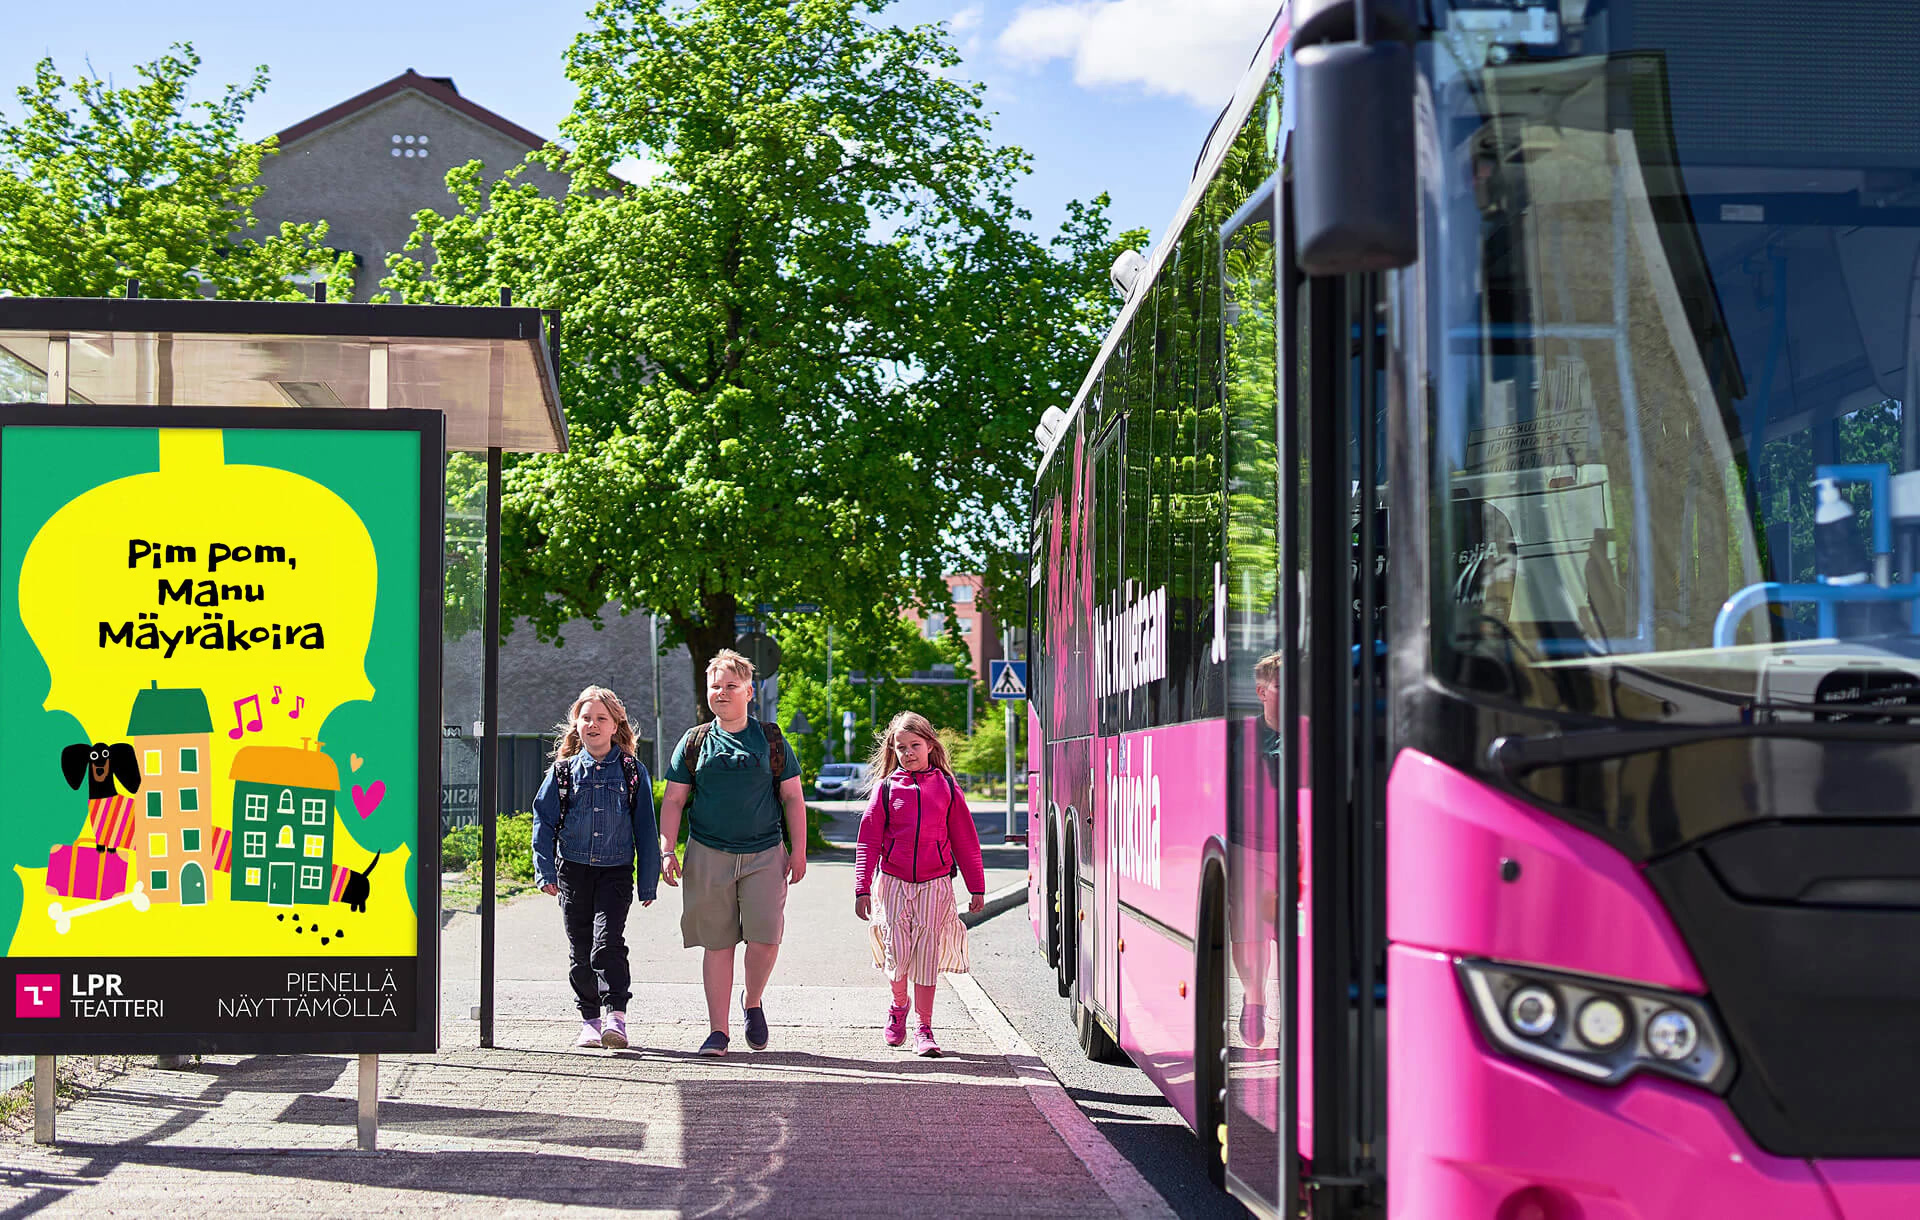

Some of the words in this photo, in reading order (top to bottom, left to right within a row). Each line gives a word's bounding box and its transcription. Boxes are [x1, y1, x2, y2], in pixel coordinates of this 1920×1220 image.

[129, 538, 197, 569] Pim
[208, 543, 297, 572] pom,
[158, 578, 265, 607] Manu
[99, 612, 325, 659] Mäyräkoira
[1095, 604, 1112, 723] Nyt
[1112, 578, 1167, 721] kuljetaan
[1106, 735, 1161, 891] Joukolla
[72, 973, 124, 996] LPR
[288, 969, 398, 992] PIENELLÄ
[70, 999, 164, 1018] TEATTERI
[218, 993, 398, 1018] NÄYTTÄMÖLLÄ
